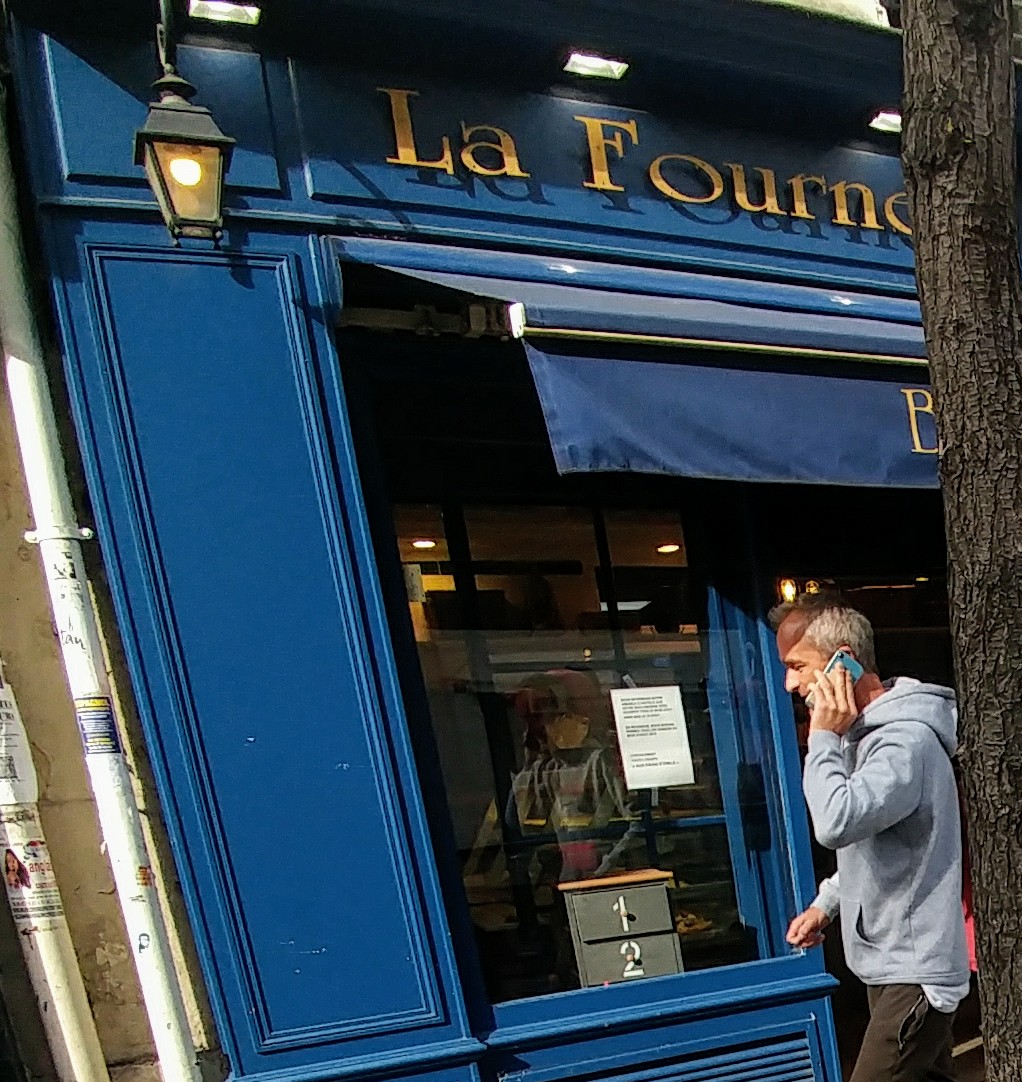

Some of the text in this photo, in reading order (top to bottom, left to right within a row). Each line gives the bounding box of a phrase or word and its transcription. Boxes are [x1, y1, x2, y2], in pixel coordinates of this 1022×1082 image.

[376, 87, 530, 179] La
[612, 895, 629, 932] 1
[620, 941, 645, 978] 2
